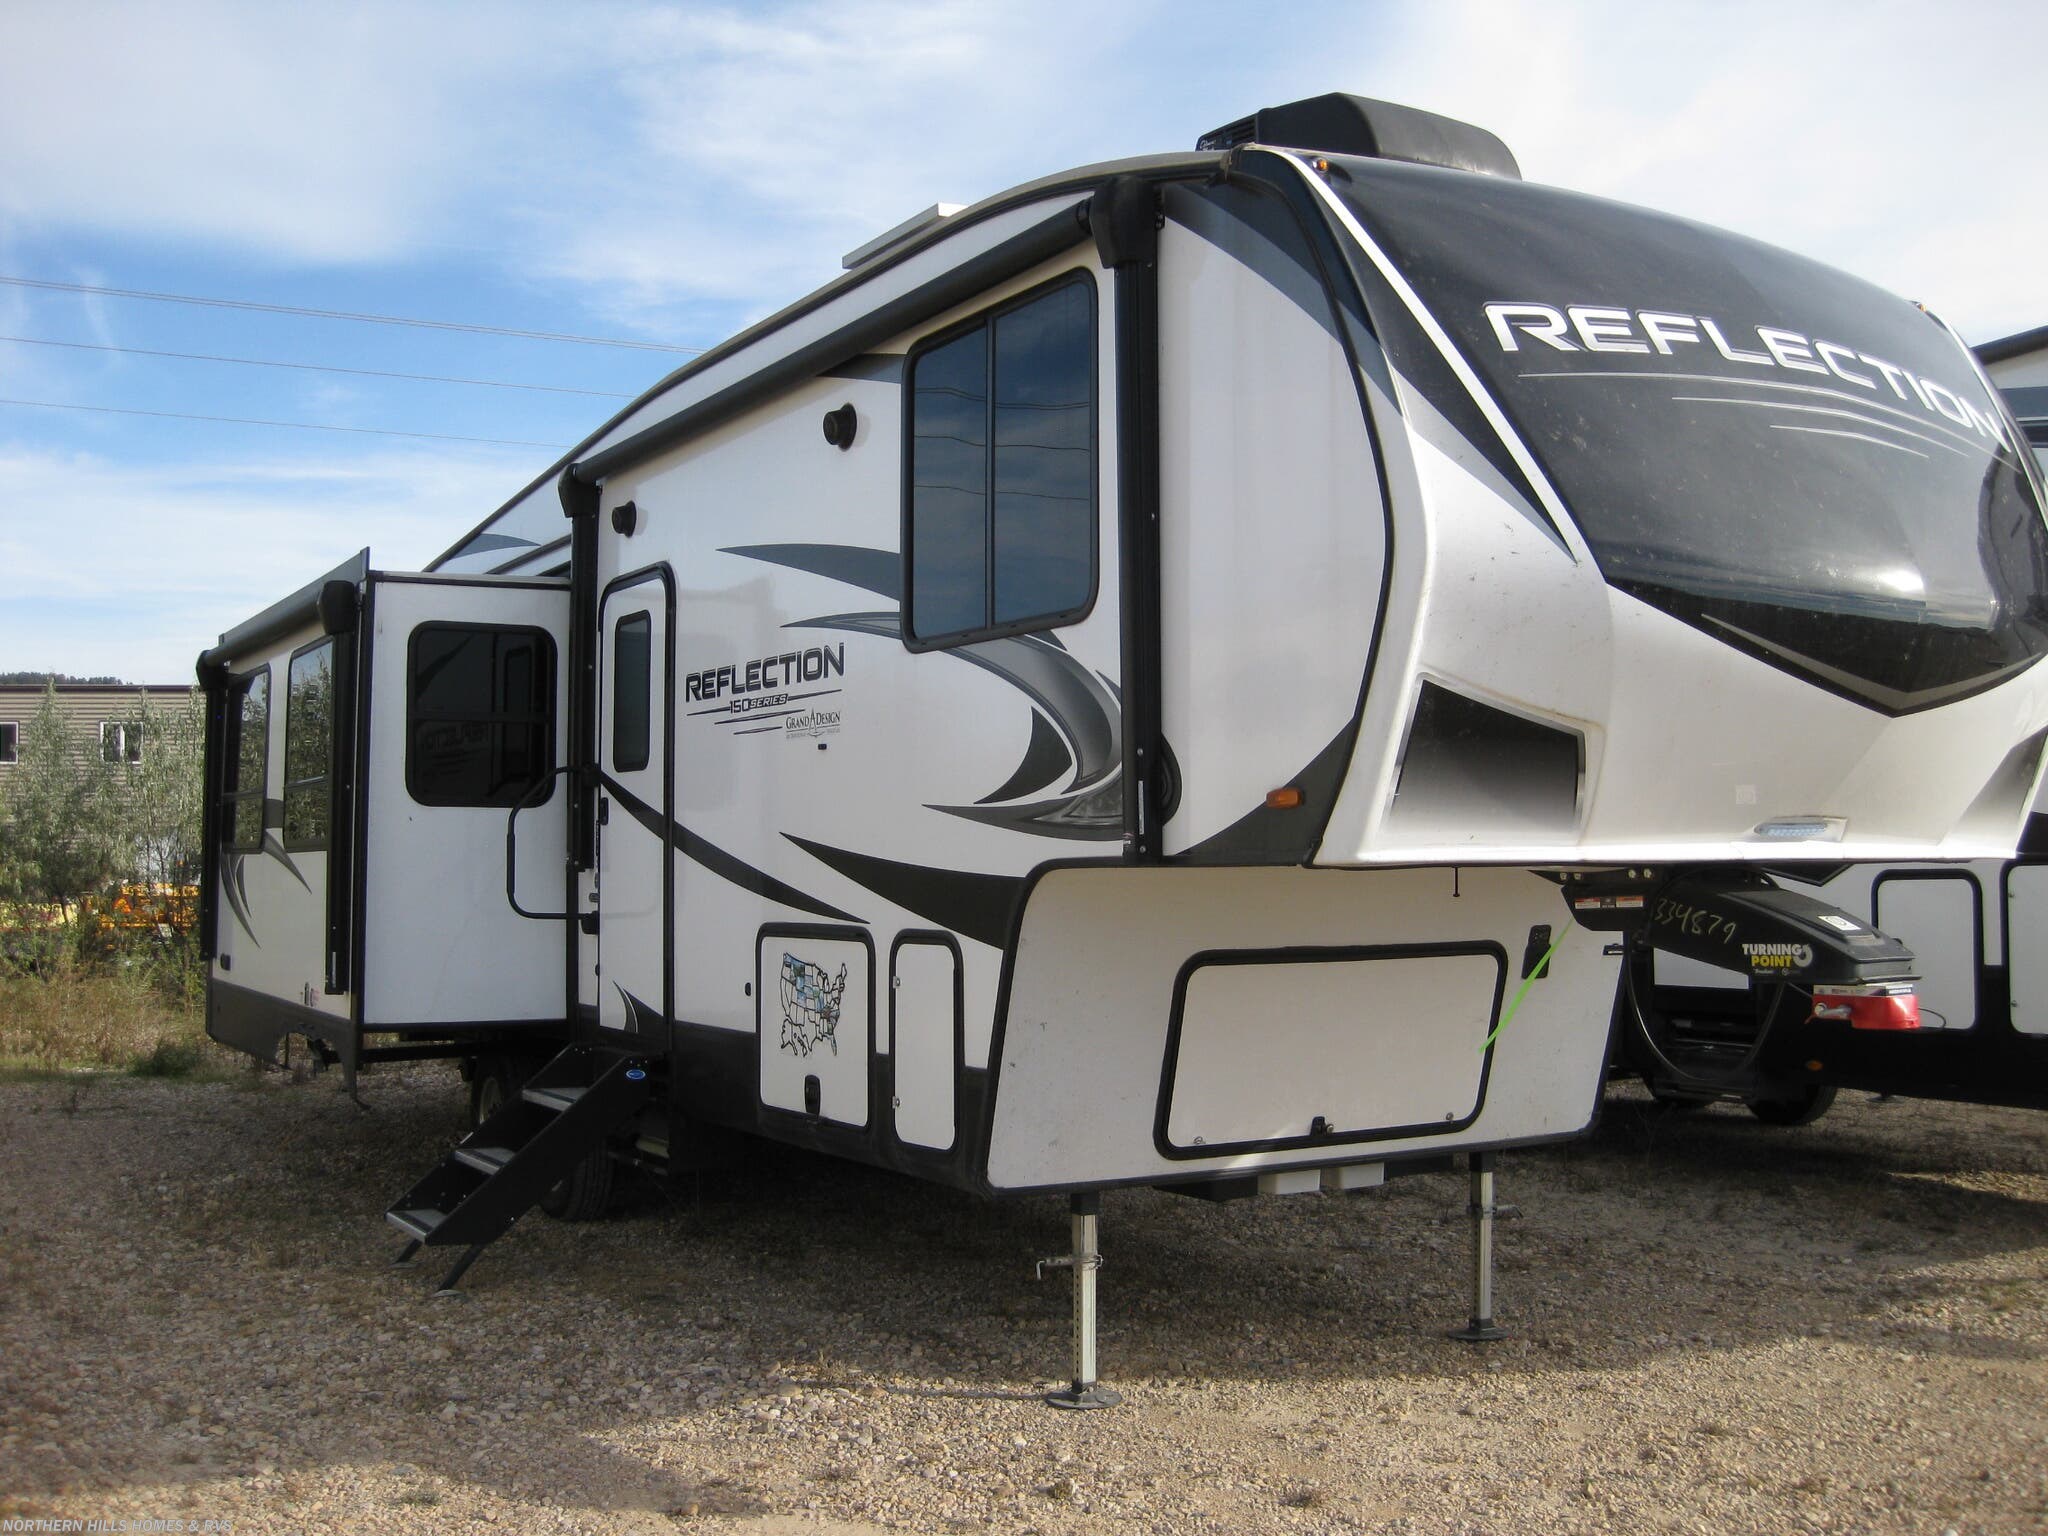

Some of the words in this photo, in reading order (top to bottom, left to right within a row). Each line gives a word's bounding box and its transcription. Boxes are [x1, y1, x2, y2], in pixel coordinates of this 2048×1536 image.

[1483, 301, 2011, 452] REFLECTION
[685, 642, 844, 702] REFLECTION
[1742, 943, 1802, 955] TURNING
